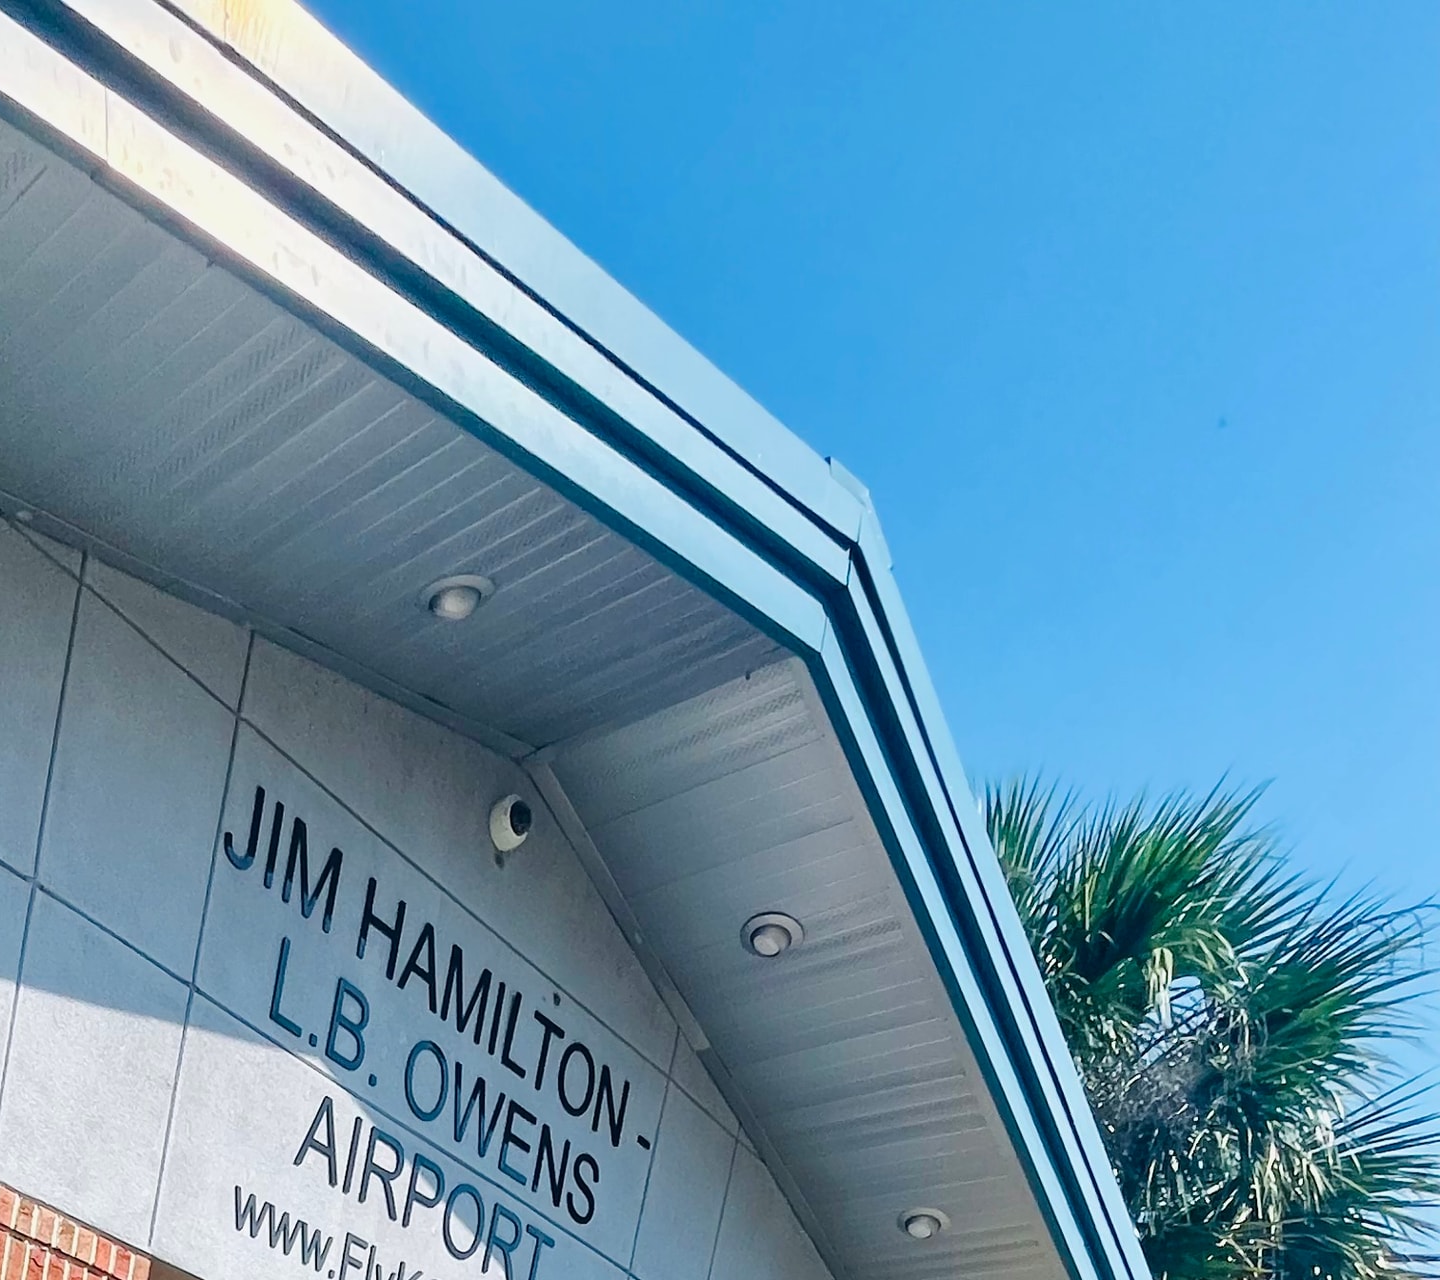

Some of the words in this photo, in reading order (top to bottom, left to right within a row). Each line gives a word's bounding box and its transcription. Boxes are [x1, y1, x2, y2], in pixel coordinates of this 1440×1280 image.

[224, 785, 343, 933] JIM
[269, 936, 378, 1087] L.B.
[404, 1039, 600, 1226] OWENS
